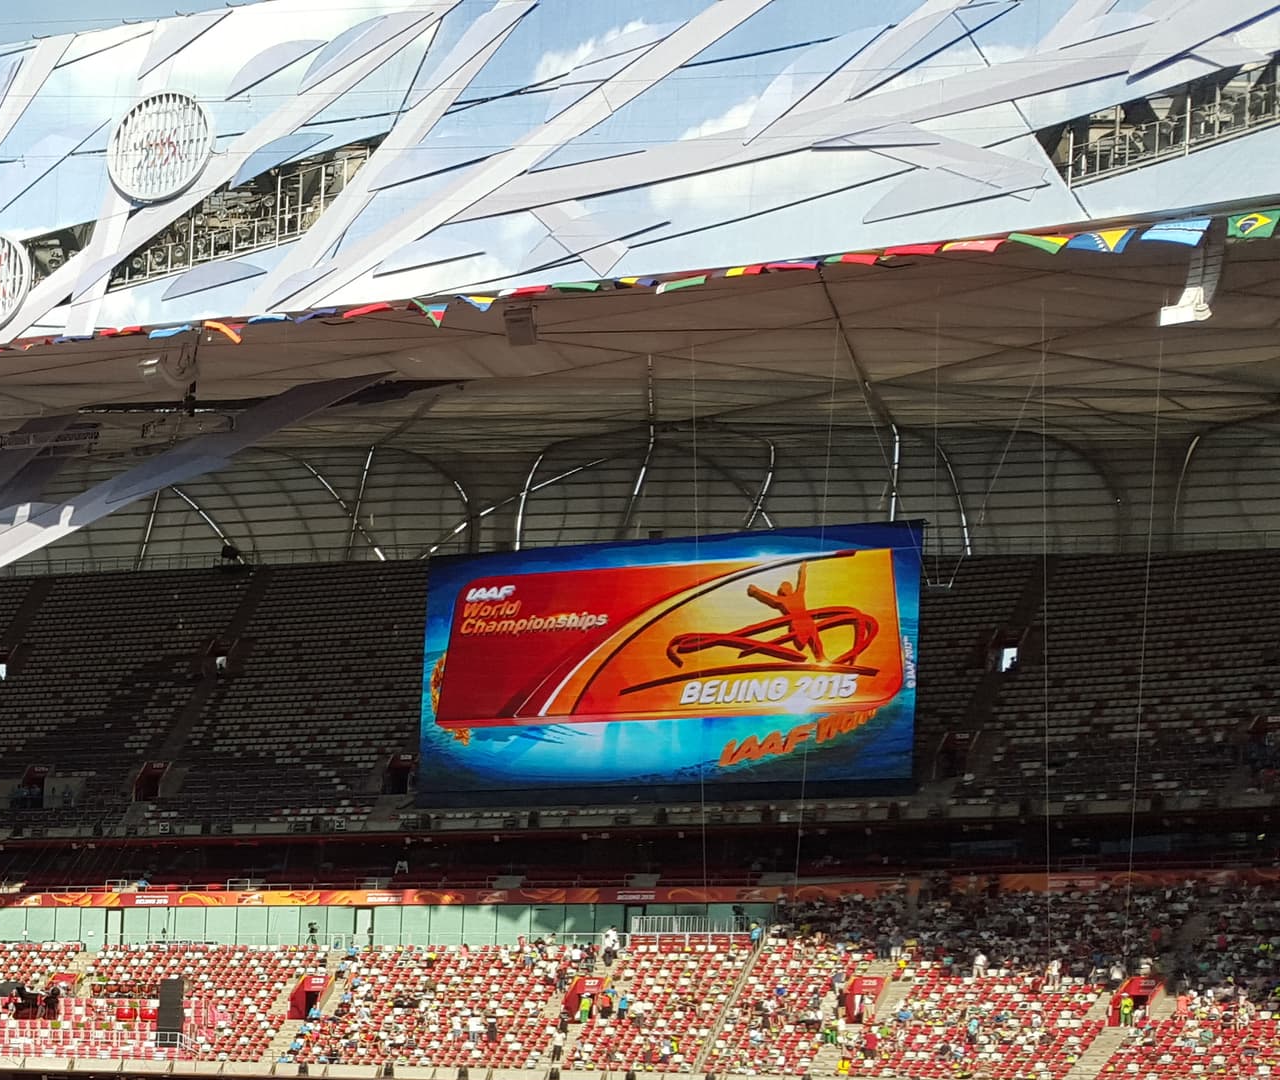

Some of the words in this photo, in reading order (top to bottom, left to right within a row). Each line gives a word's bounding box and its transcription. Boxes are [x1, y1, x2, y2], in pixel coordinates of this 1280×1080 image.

[466, 585, 516, 602] IAAF
[463, 600, 521, 618] World
[460, 611, 608, 635] Championships
[680, 676, 788, 705] BEIJING
[795, 673, 859, 701] 2015
[719, 723, 816, 767] IAAF
